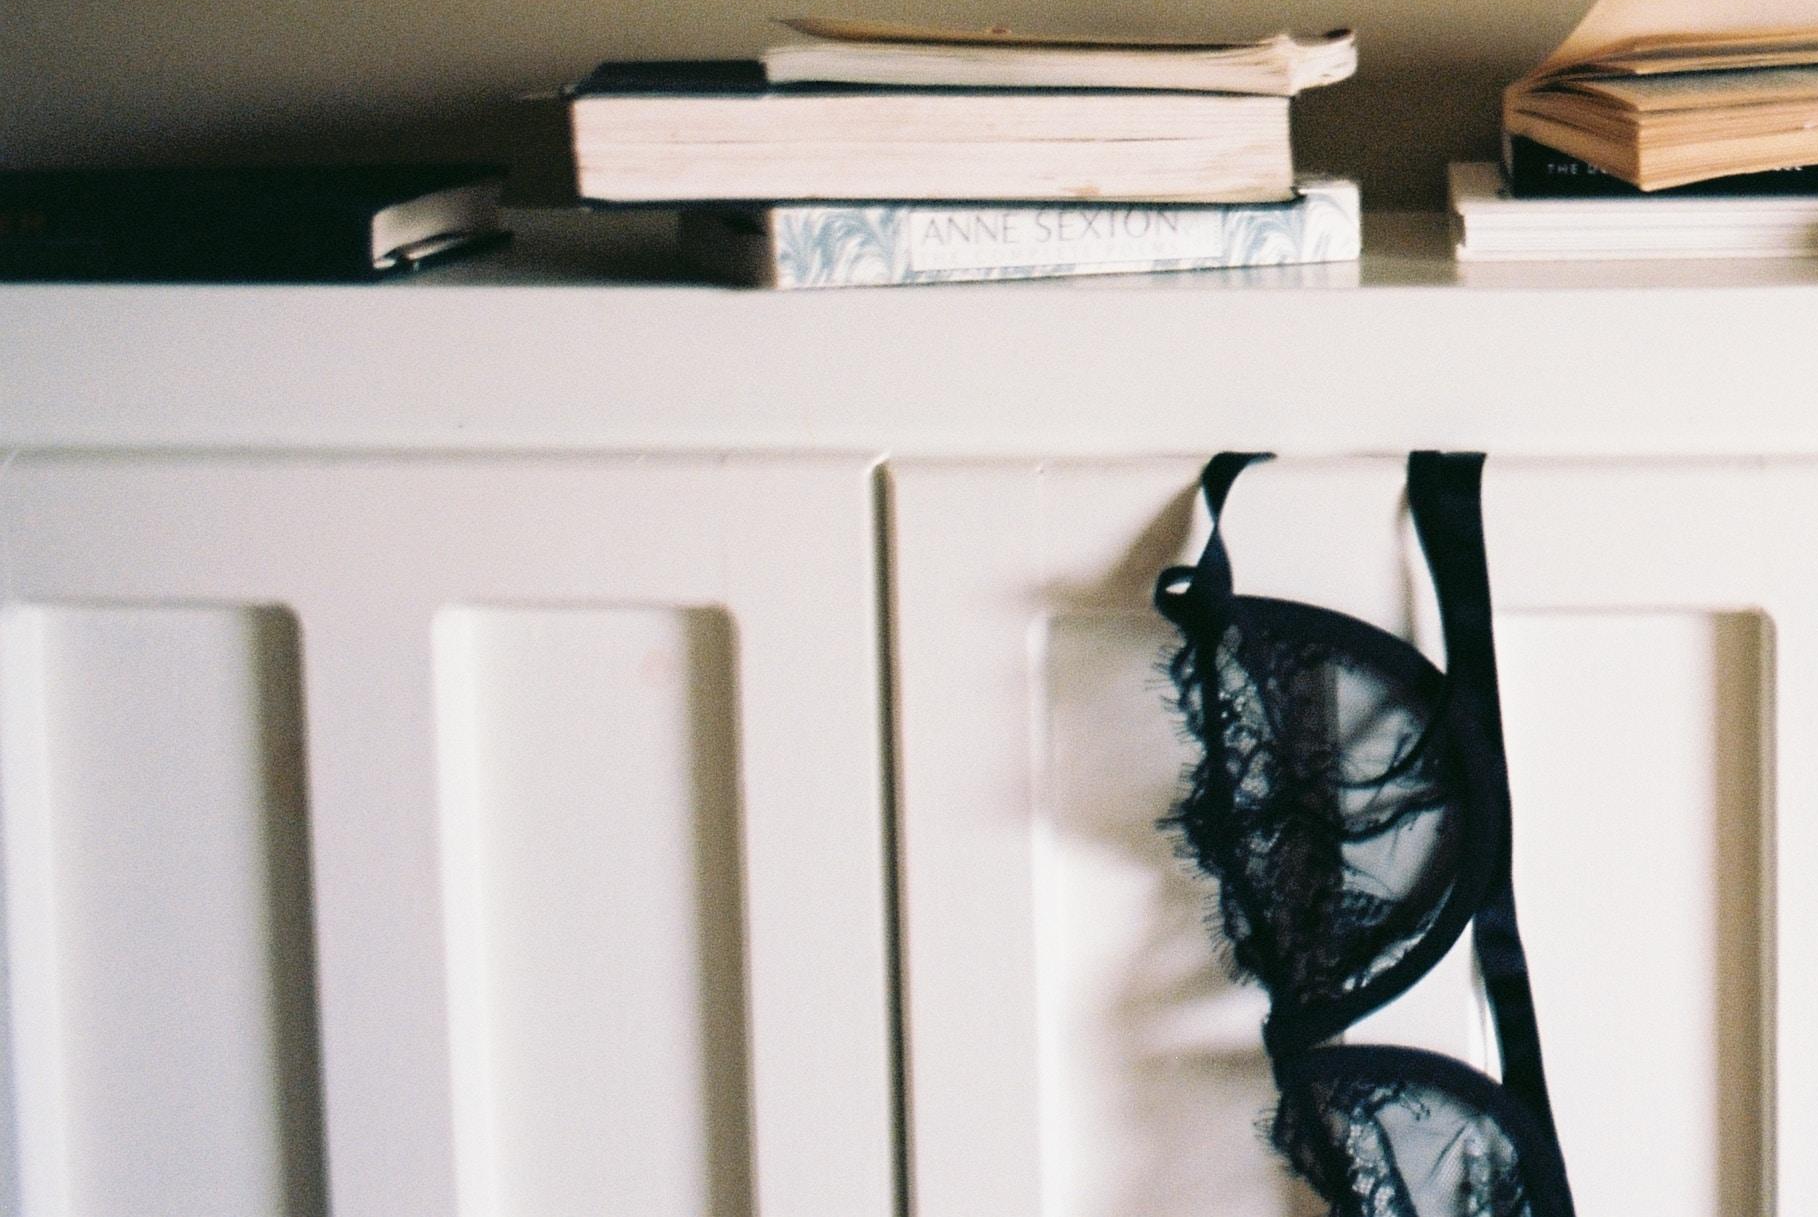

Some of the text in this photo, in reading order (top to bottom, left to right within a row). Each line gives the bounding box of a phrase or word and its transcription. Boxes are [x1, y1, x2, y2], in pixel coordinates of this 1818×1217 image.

[1547, 162, 1579, 175] THE
[921, 209, 1179, 246] ANNE SEXTON
